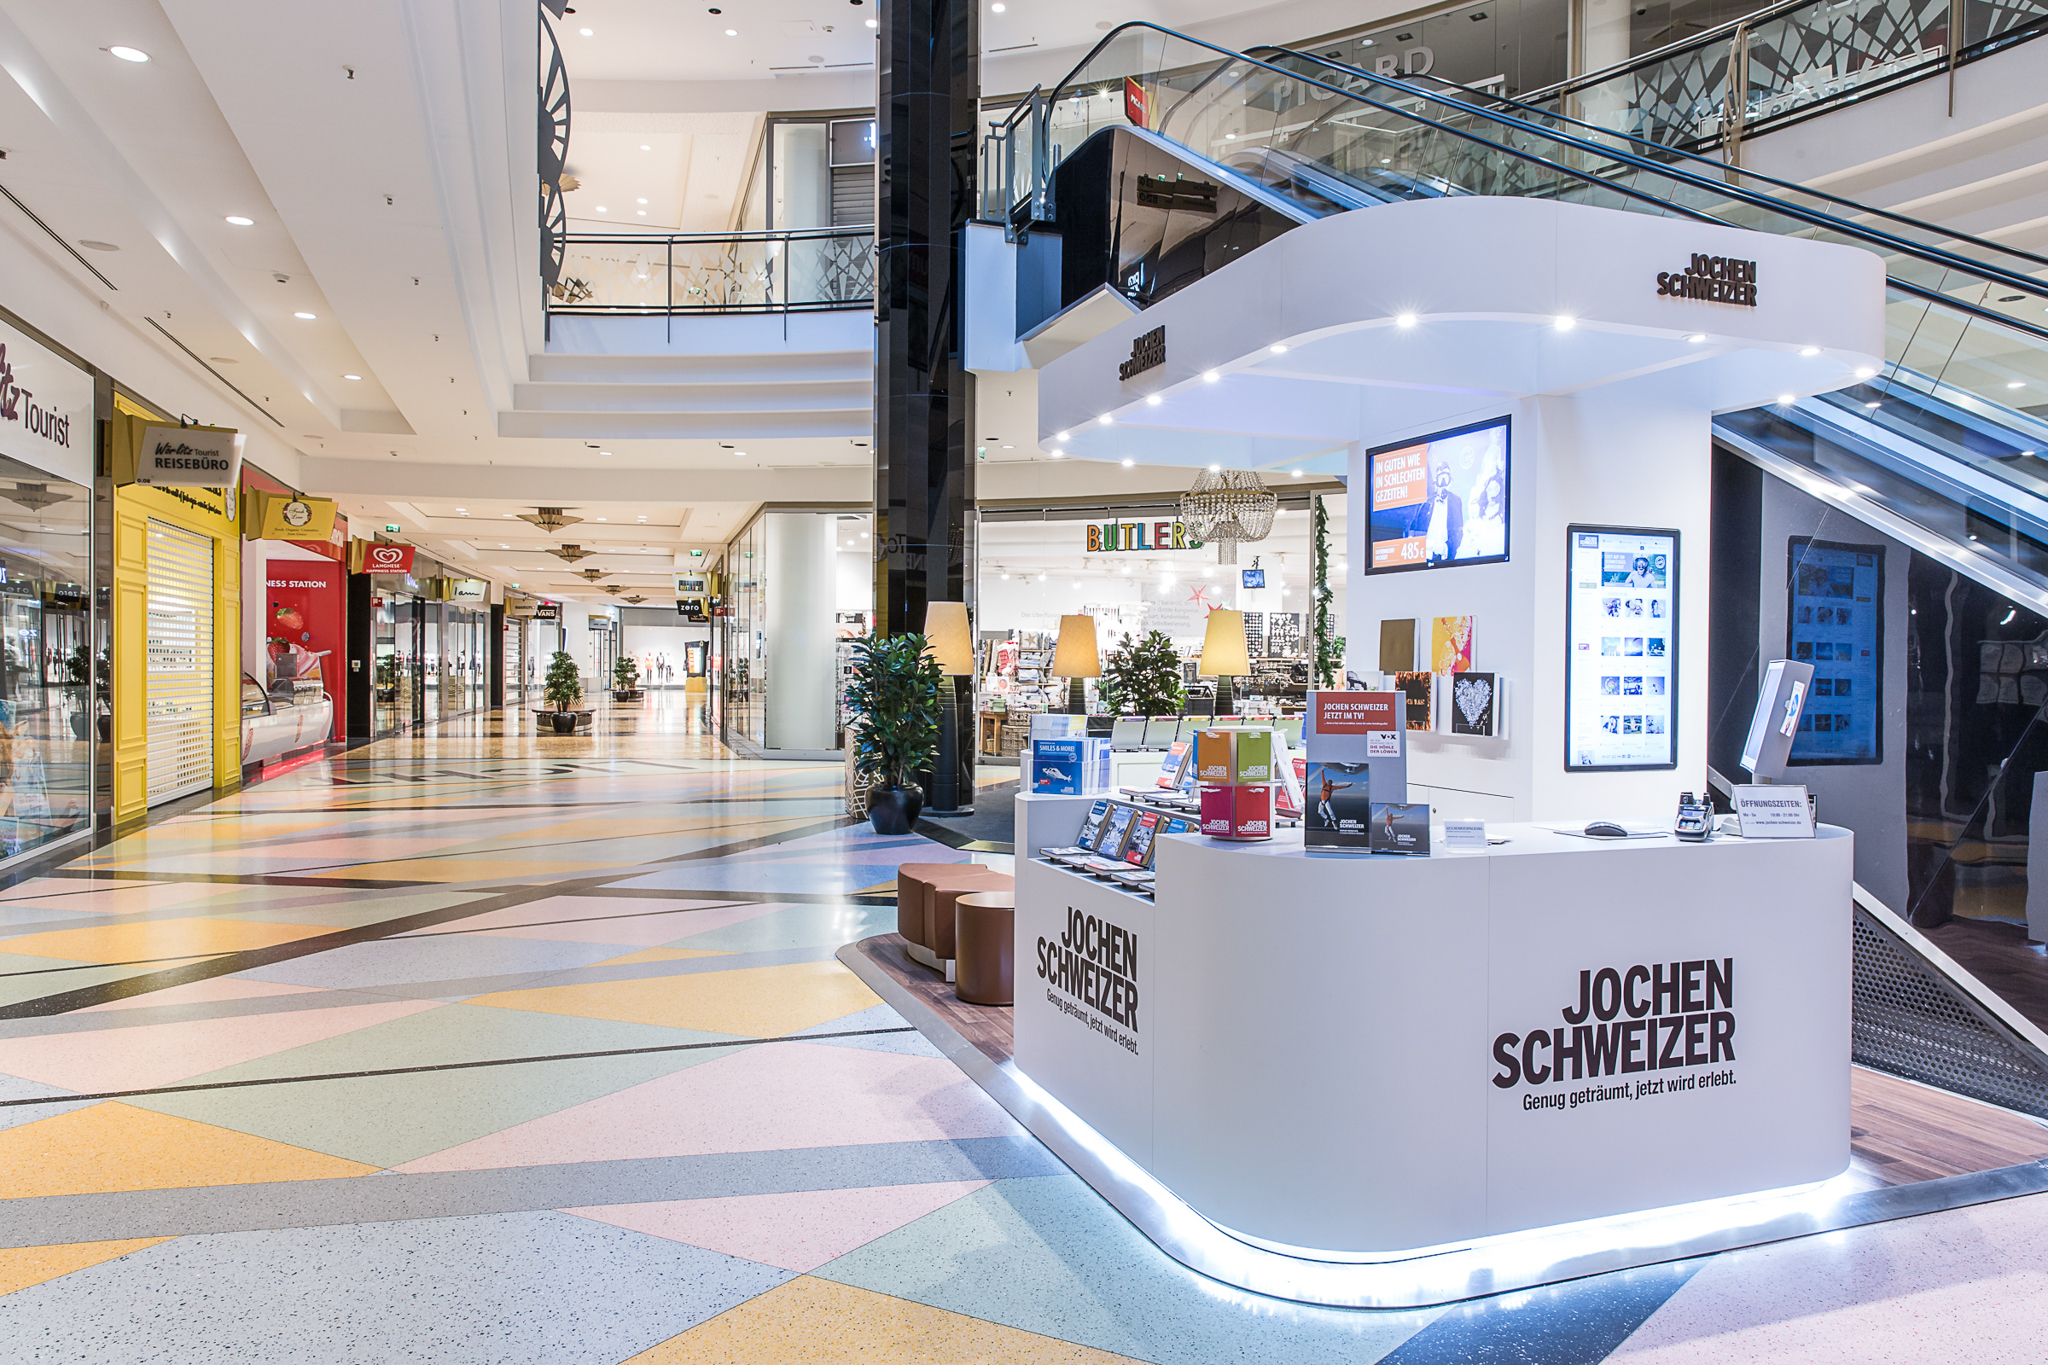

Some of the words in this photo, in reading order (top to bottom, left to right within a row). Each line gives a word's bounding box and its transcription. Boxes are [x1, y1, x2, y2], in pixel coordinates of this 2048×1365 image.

[1274, 46, 1434, 112] PICARD
[1684, 253, 1756, 284] JOCHEN
[1656, 272, 1757, 306] SCHWEIZER
[1130, 324, 1166, 358] JOCHEN
[1119, 344, 1166, 382] SCHWEIZER
[21, 388, 70, 448] Tourist
[155, 457, 229, 470] REISEBÜRO
[1376, 461, 1383, 474] IN
[1384, 456, 1406, 472] GUTEN
[1407, 452, 1420, 468] WIE
[1376, 476, 1383, 489] IN
[1384, 466, 1426, 487] SCHLECHTEN
[1375, 485, 1408, 503] GEZEITEN!
[1401, 542, 1419, 560] 485
[1061, 906, 1138, 982] JOCHEN
[1037, 936, 1138, 1033] SCHWEIZER
[1562, 958, 1733, 1025] JOCHEN
[1046, 988, 1063, 1011] Genug
[1064, 1000, 1090, 1028] geträumt,
[1090, 1014, 1103, 1034] jetzt
[1104, 1025, 1118, 1042] wird
[1118, 1034, 1138, 1056] erlebt.
[1492, 1011, 1736, 1089] SCHWEIZER
[1522, 1092, 1566, 1110] Genug
[1570, 1082, 1633, 1108] geträumt,
[1635, 1080, 1664, 1100] jetzt
[1667, 1074, 1695, 1092] wird
[1699, 1070, 1737, 1088] erlebt.
